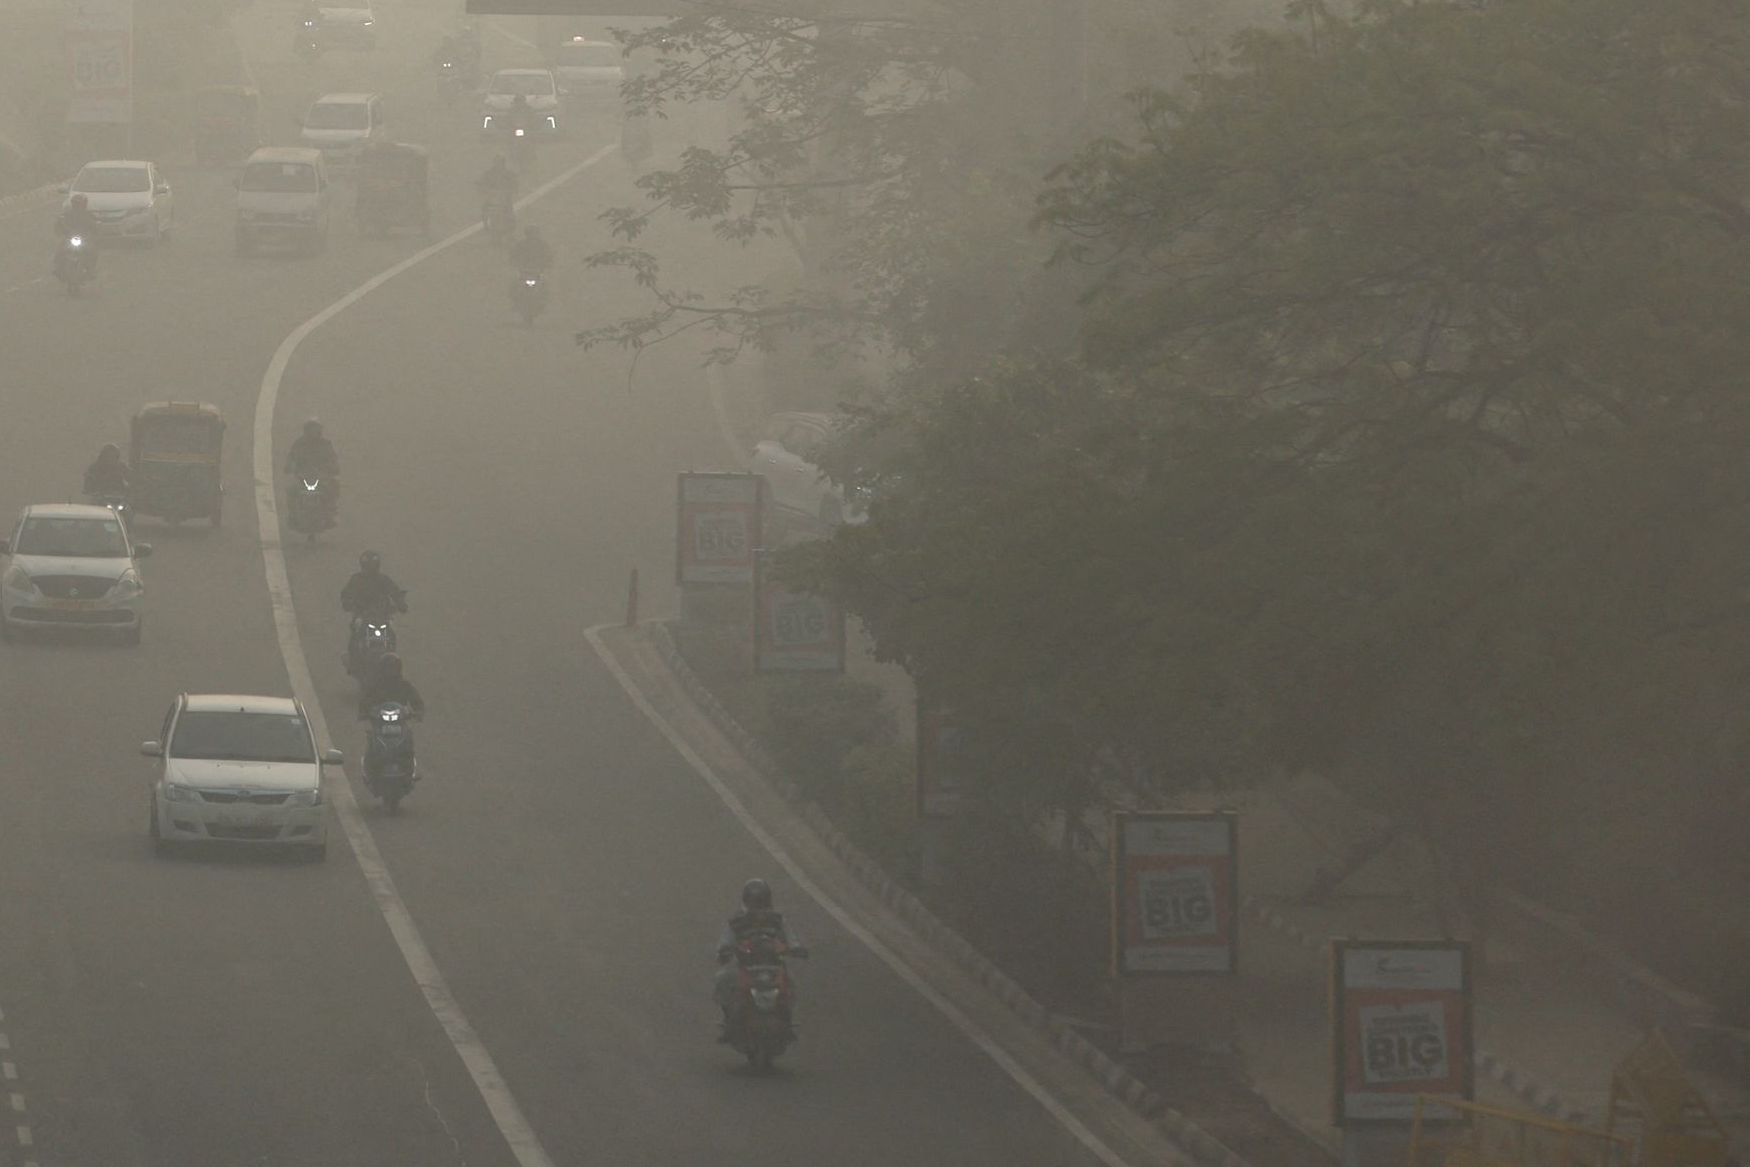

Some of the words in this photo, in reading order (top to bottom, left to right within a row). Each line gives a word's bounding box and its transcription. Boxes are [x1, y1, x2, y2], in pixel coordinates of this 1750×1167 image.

[76, 61, 120, 81] BIG
[699, 531, 745, 552] BIG
[776, 613, 824, 641] BIG
[1146, 895, 1210, 926] BIG
[1367, 1034, 1443, 1071] BIG
